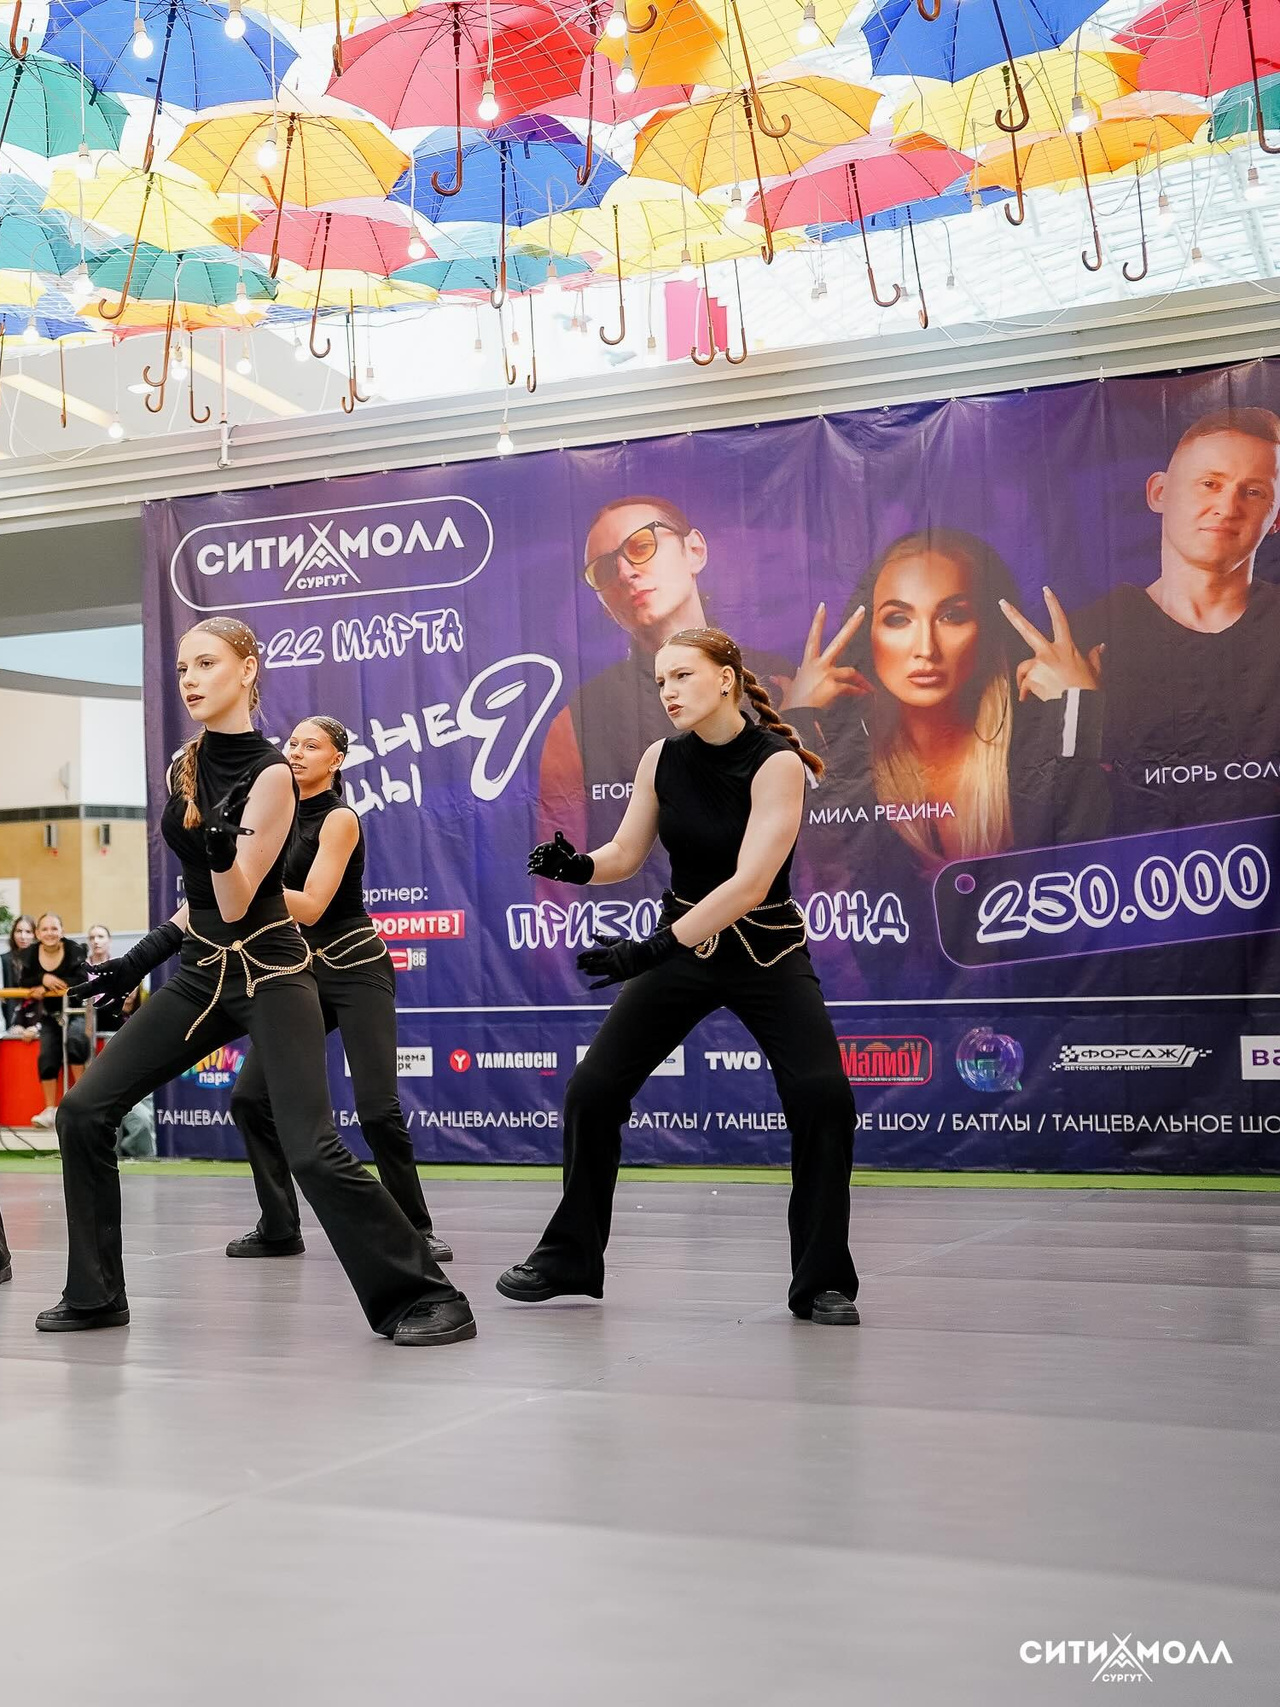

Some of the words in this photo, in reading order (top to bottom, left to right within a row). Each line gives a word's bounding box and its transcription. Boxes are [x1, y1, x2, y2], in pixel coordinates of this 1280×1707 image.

[296, 573, 348, 590] СУРГУТ
[332, 607, 464, 663] МАРТА
[1145, 764, 1218, 785] ИГОРЬ
[1224, 761, 1280, 781] СОЛ
[808, 808, 870, 826] МИЛА
[874, 801, 955, 823] РЕДИНА
[362, 886, 429, 906] артнер:
[976, 843, 1271, 943] 250.000
[506, 900, 665, 949] ПРИЗО
[800, 890, 910, 944] ОНД
[476, 1052, 557, 1069] YAMAGUCHI
[704, 1051, 761, 1070] TWO
[1081, 1049, 1179, 1059] ФОРСАЖ
[397, 1062, 412, 1072] рк
[157, 1109, 236, 1127] ТАНЦЕВАЛ
[419, 1110, 558, 1129] ТАНЦЕВАЛЬНОЕ
[628, 1112, 698, 1129] БАТТЛЫ
[879, 1113, 930, 1131] ШОУ
[952, 1113, 1031, 1132] БАТТЛЫ
[1052, 1114, 1233, 1134] ТАНЦЕВАЛЬНОЕ
[1240, 1115, 1280, 1134] ШО
